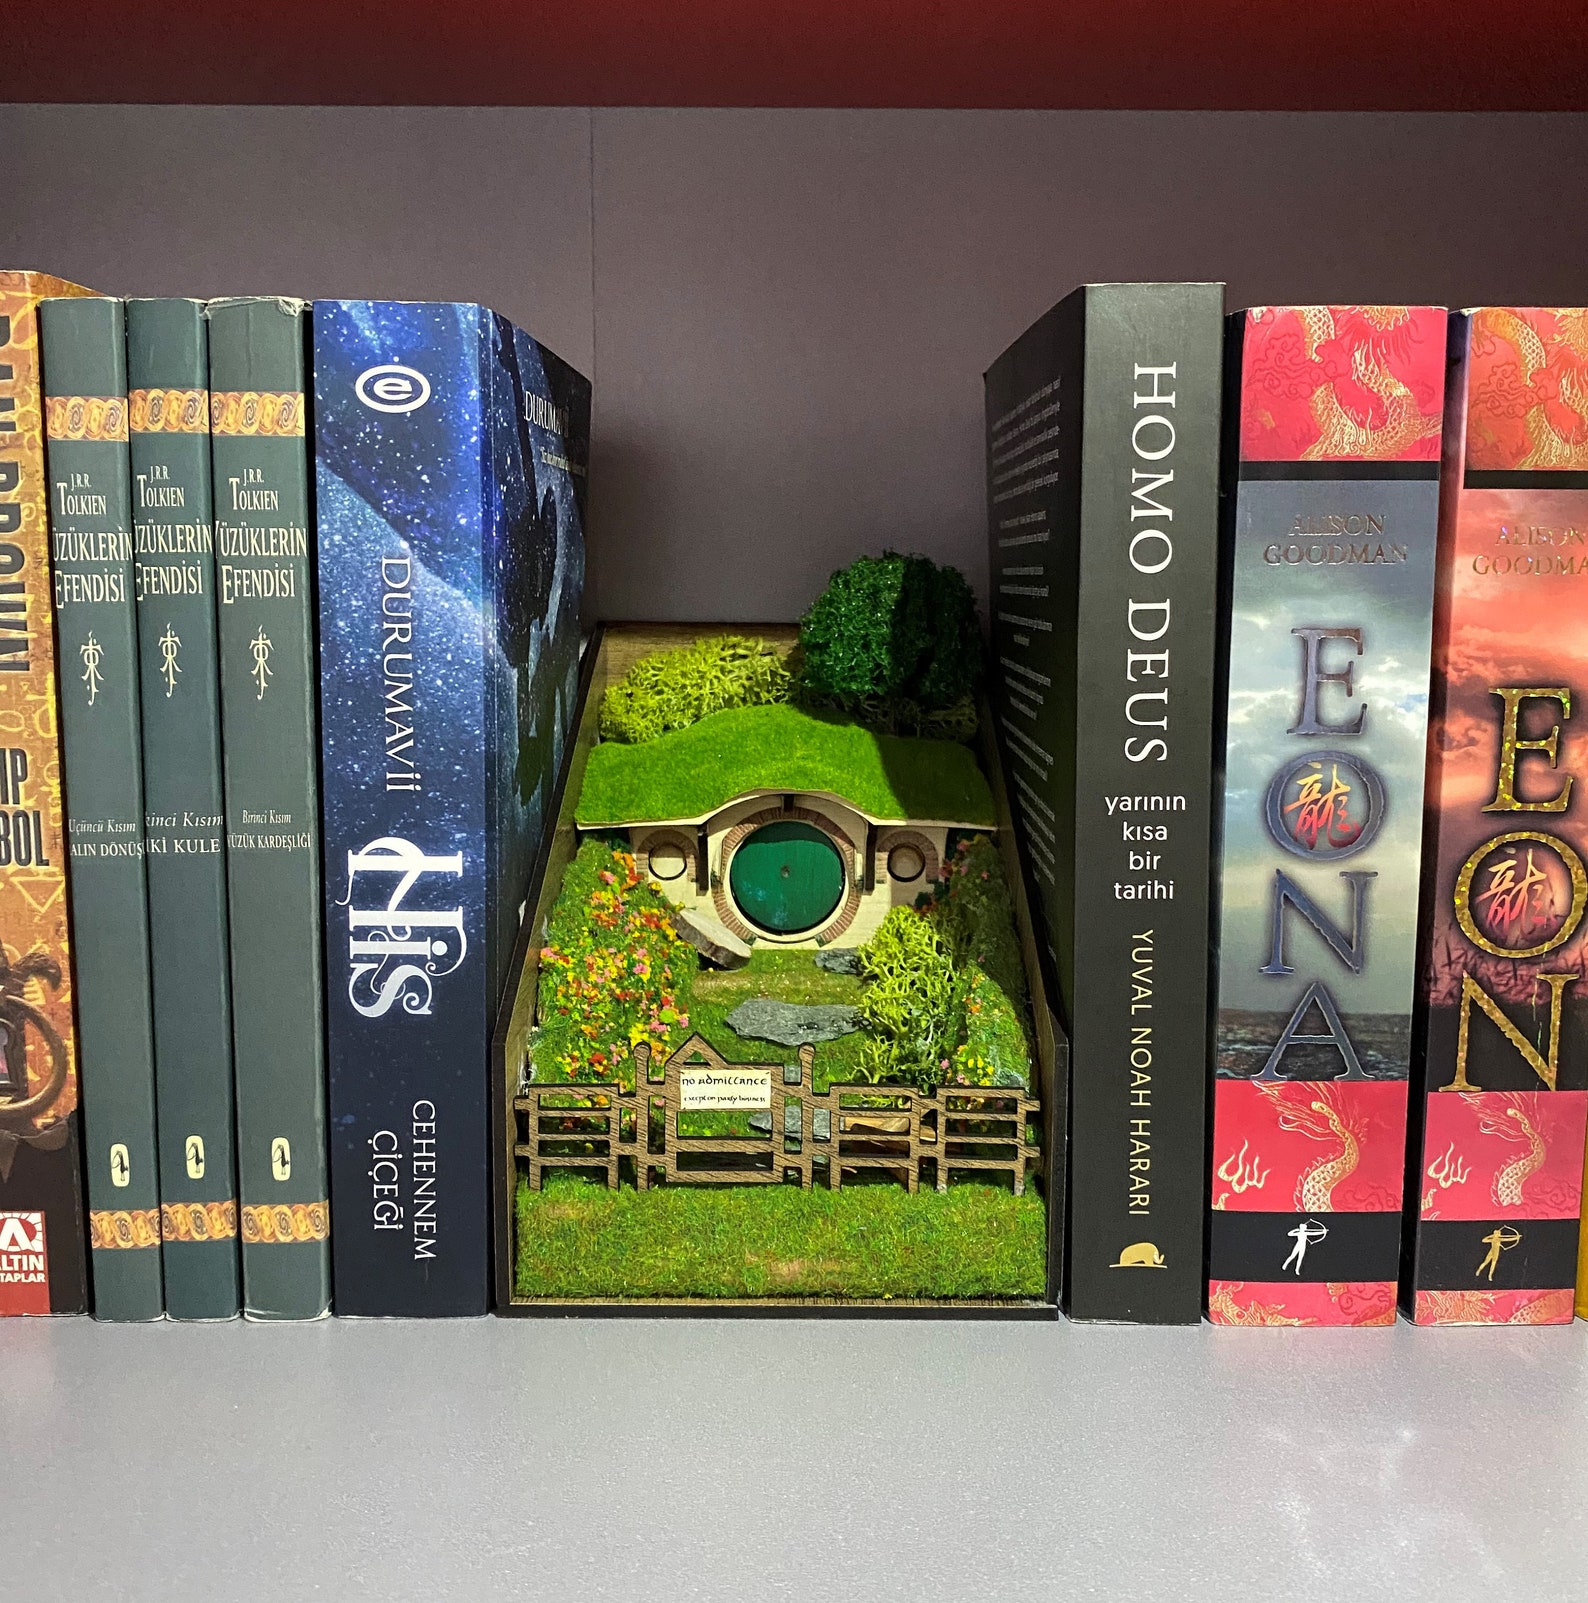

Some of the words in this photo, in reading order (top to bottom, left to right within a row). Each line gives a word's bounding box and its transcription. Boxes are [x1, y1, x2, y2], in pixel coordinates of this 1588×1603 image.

[150, 466, 170, 483] J.R.R.
[243, 468, 264, 485] J.R.R.
[1129, 361, 1177, 574] HOMO
[70, 473, 92, 491] J.R.R.
[1288, 513, 1386, 536] ALISON
[1495, 526, 1587, 547] ALISON
[1263, 543, 1409, 566] GOODMAN
[1124, 598, 1170, 762] DEUS
[1104, 795, 1186, 816] yarının
[1122, 821, 1168, 841] kısa
[174, 838, 221, 854] KULE
[1129, 851, 1161, 870] bir
[1113, 880, 1174, 900] tarihi
[1131, 929, 1153, 1016] YUVAL
[1130, 1027, 1152, 1106] NOAH
[682, 1077, 695, 1086] no
[698, 1074, 767, 1086] admittance
[1128, 1119, 1151, 1215] HARARI
[412, 1100, 437, 1260] CEHENNEM
[0, 1254, 44, 1271] LTIN
